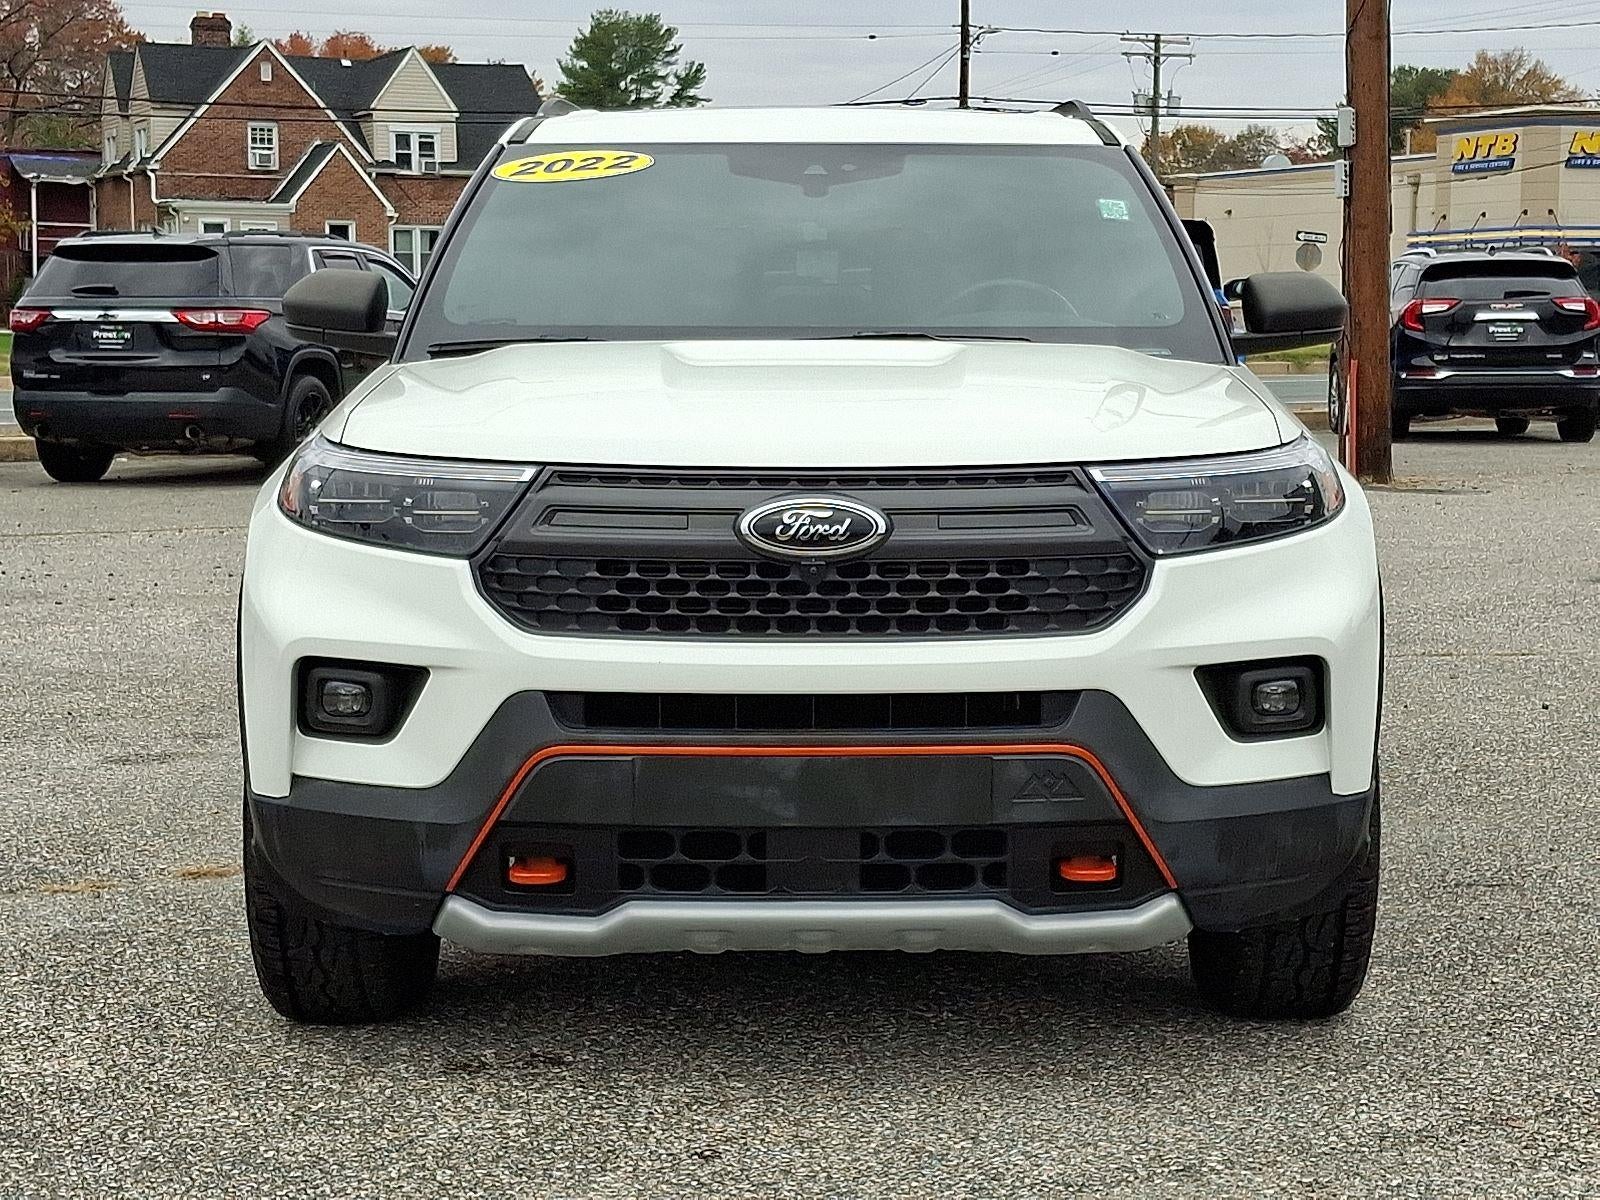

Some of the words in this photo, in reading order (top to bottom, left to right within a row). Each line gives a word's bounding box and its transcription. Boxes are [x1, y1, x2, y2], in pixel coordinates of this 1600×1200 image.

[1453, 133, 1518, 161] NTB
[508, 155, 639, 177] 2022
[775, 509, 852, 541] Ford
